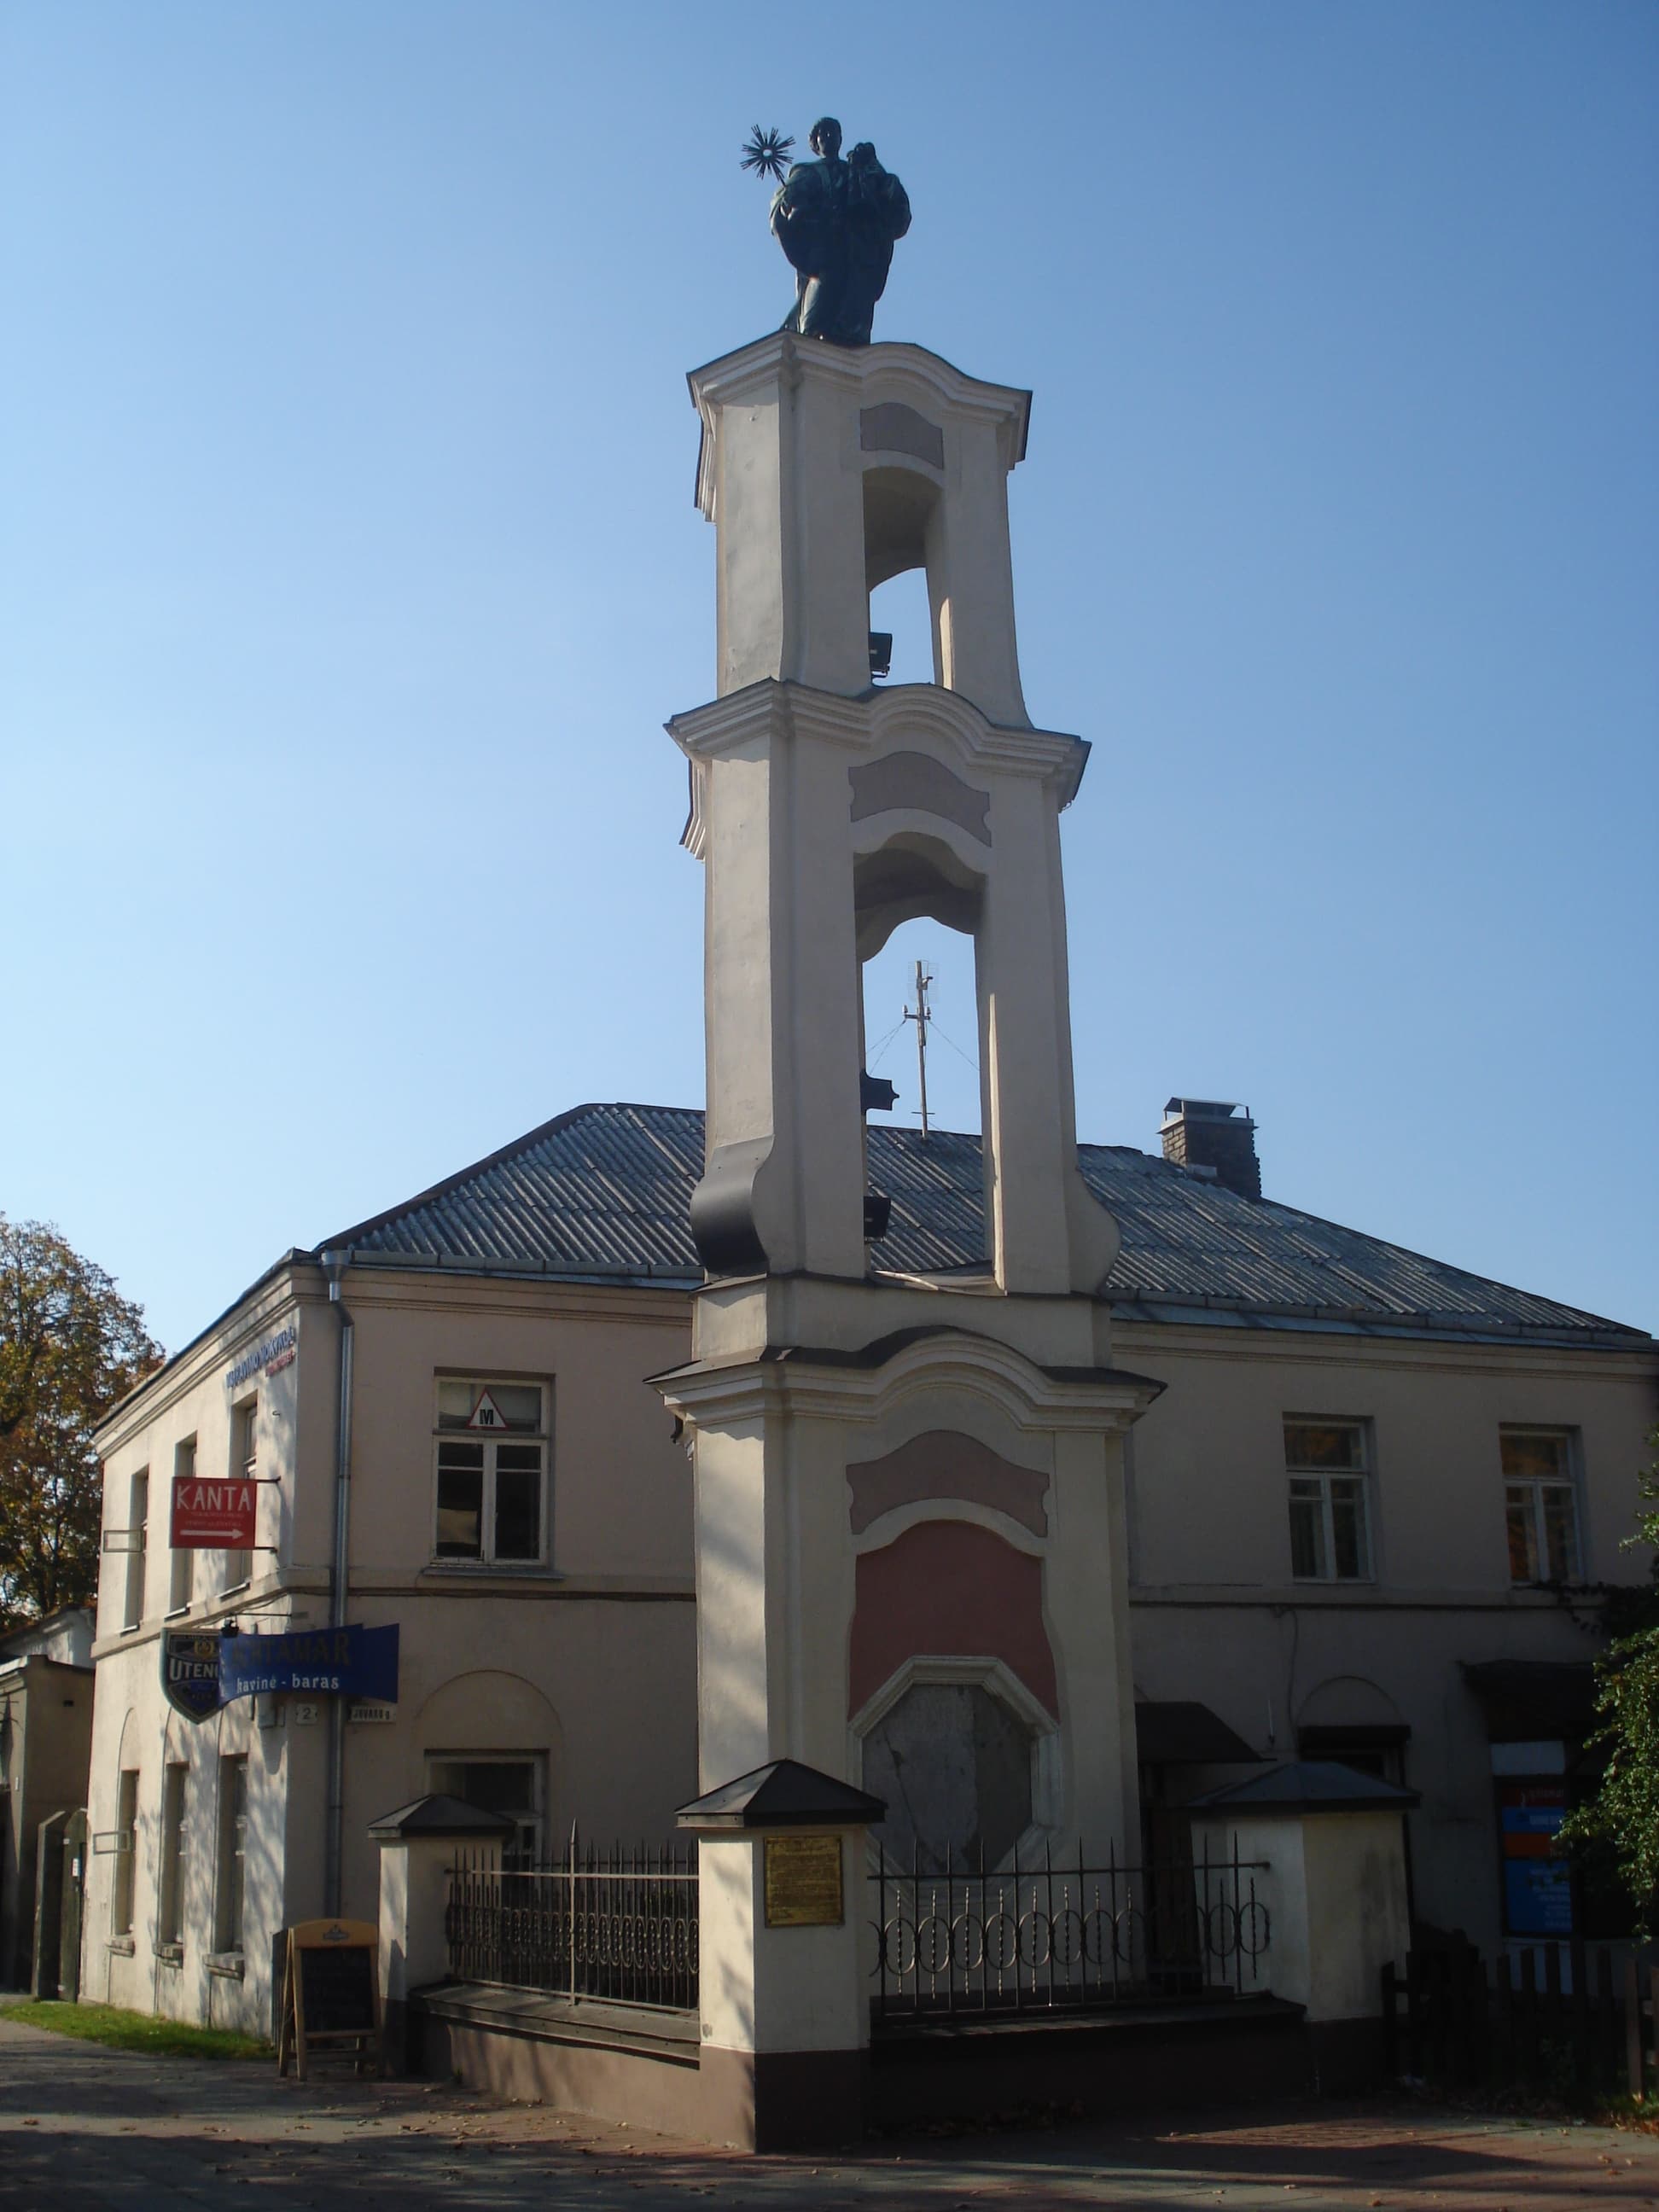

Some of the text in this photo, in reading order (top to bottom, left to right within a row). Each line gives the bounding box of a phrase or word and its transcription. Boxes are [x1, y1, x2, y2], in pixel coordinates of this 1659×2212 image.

[479, 1409, 494, 1425] M
[177, 1484, 251, 1511] KANTA
[291, 1673, 340, 1690] baras
[303, 1707, 311, 1720] 2
